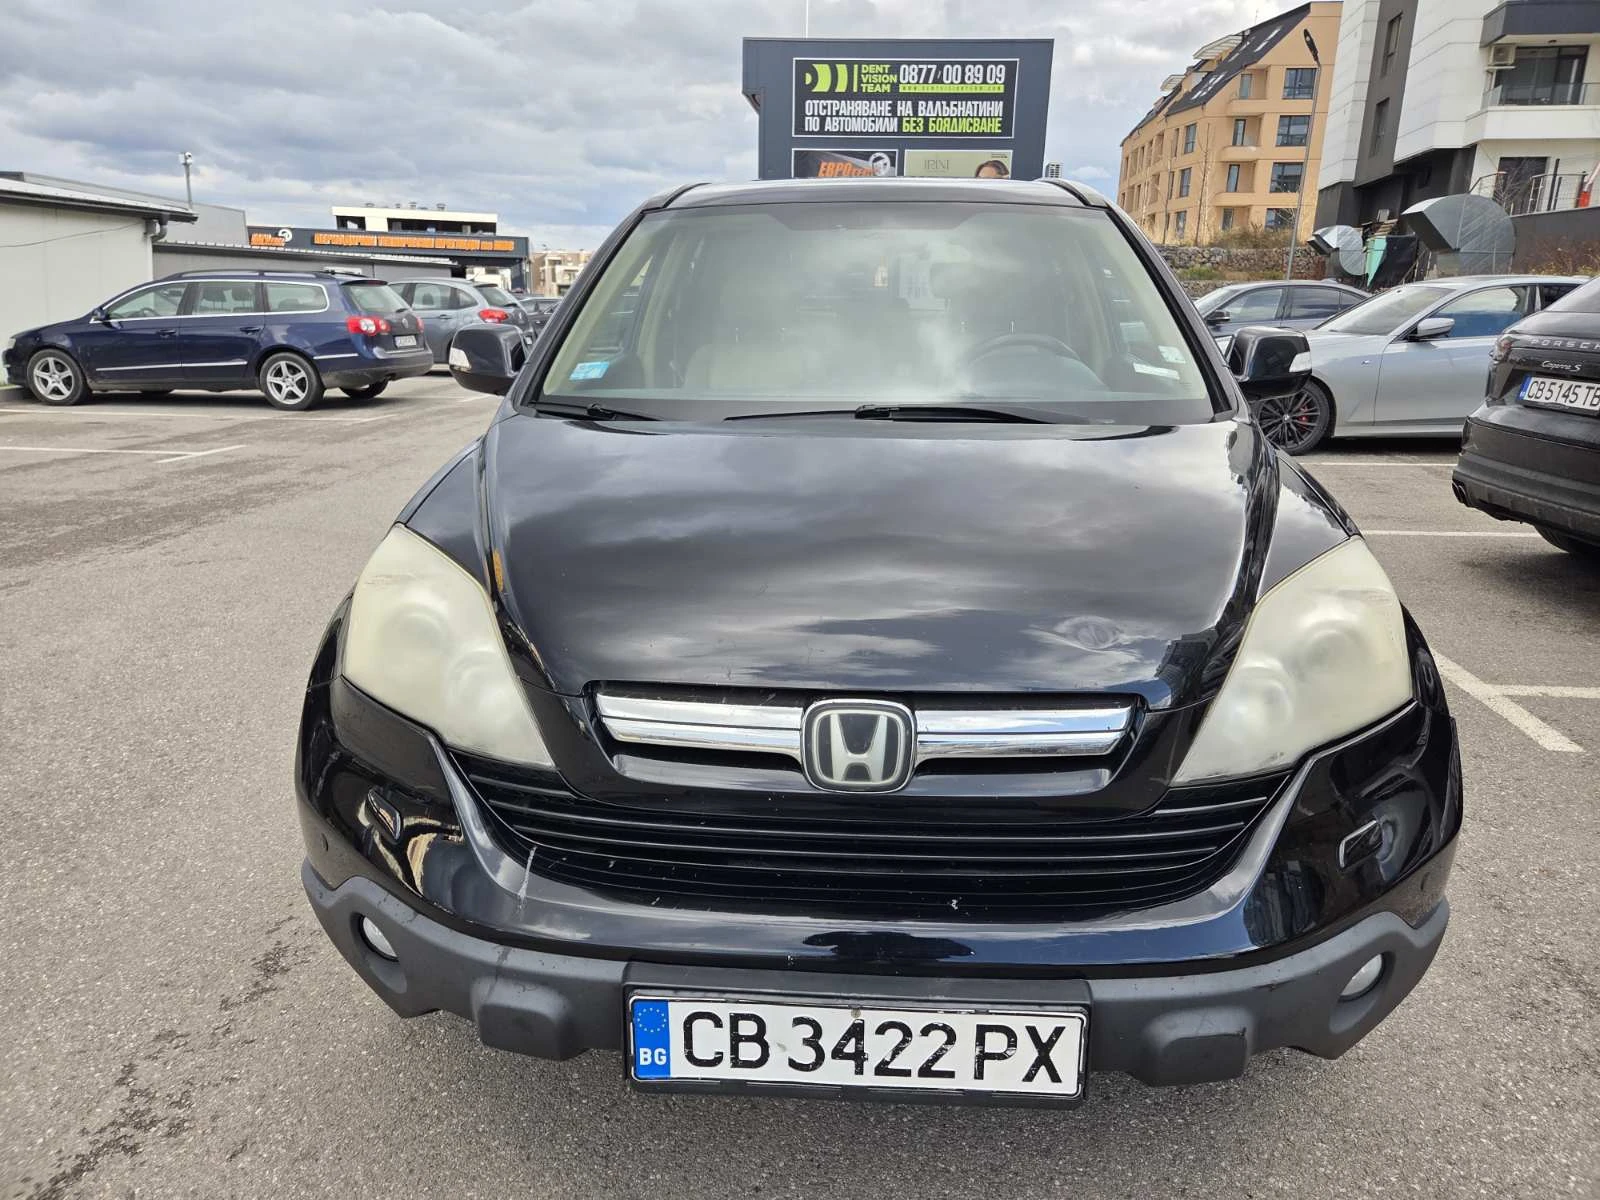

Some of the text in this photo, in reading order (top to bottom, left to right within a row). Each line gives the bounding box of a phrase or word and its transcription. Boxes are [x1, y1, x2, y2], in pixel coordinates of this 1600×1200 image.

[861, 64, 891, 73] DENT
[964, 64, 984, 84] 89
[986, 64, 1006, 84] 09
[861, 74, 898, 83] VISION
[861, 83, 891, 93] TEAM
[805, 100, 1004, 117] ОТСТРАНЯВАНЕ НА ВДЛЪБНАТИНИ
[804, 116, 1002, 133] ПО АВТОМОБИЛИ БЕЗ БОЯДИСВАНЕ
[1527, 381, 1600, 407] CB 5145 TB
[682, 1011, 1066, 1084] CB 3422 PX
[639, 1048, 667, 1067] BG
